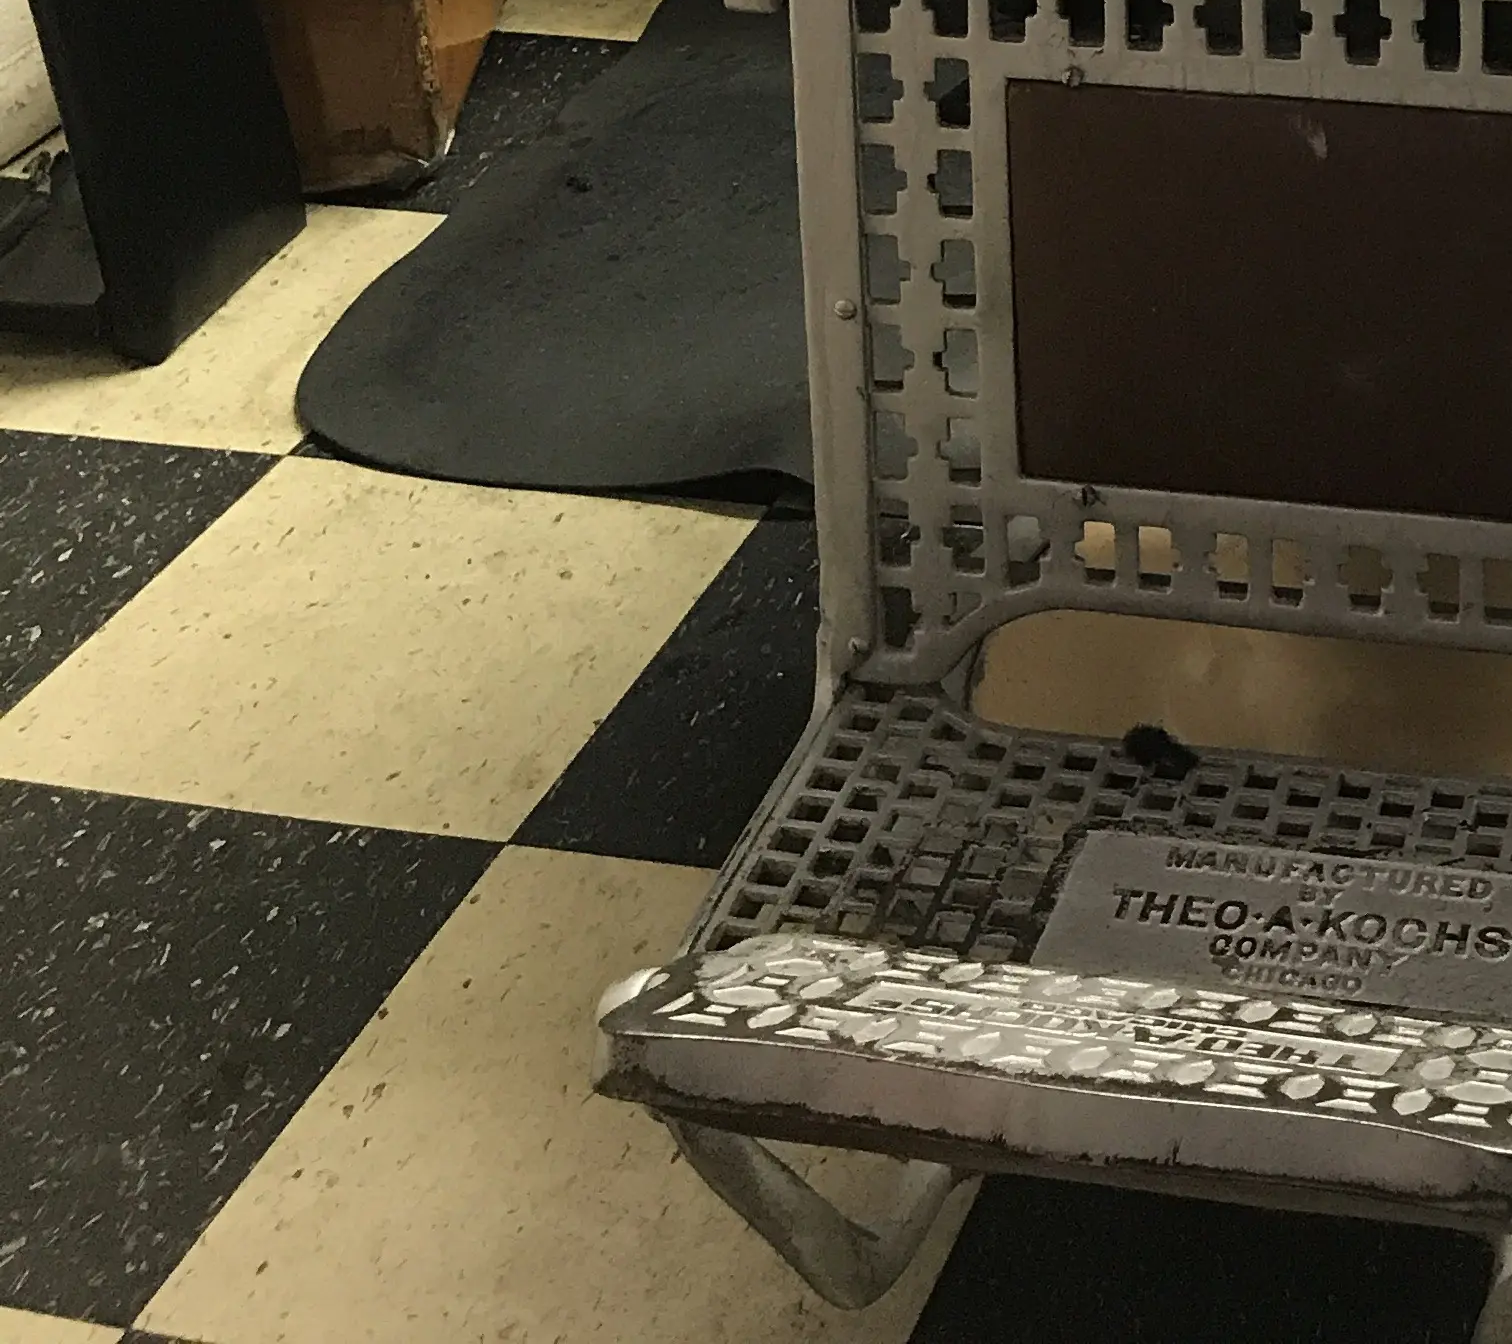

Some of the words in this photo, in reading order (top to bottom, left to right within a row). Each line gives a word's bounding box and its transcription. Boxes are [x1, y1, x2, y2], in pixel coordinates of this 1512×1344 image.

[1164, 844, 1496, 901] MANUFACTURED
[1297, 885, 1345, 908] BY
[1208, 933, 1410, 978] COMPANY
[1221, 965, 1365, 996] CHICAGO
